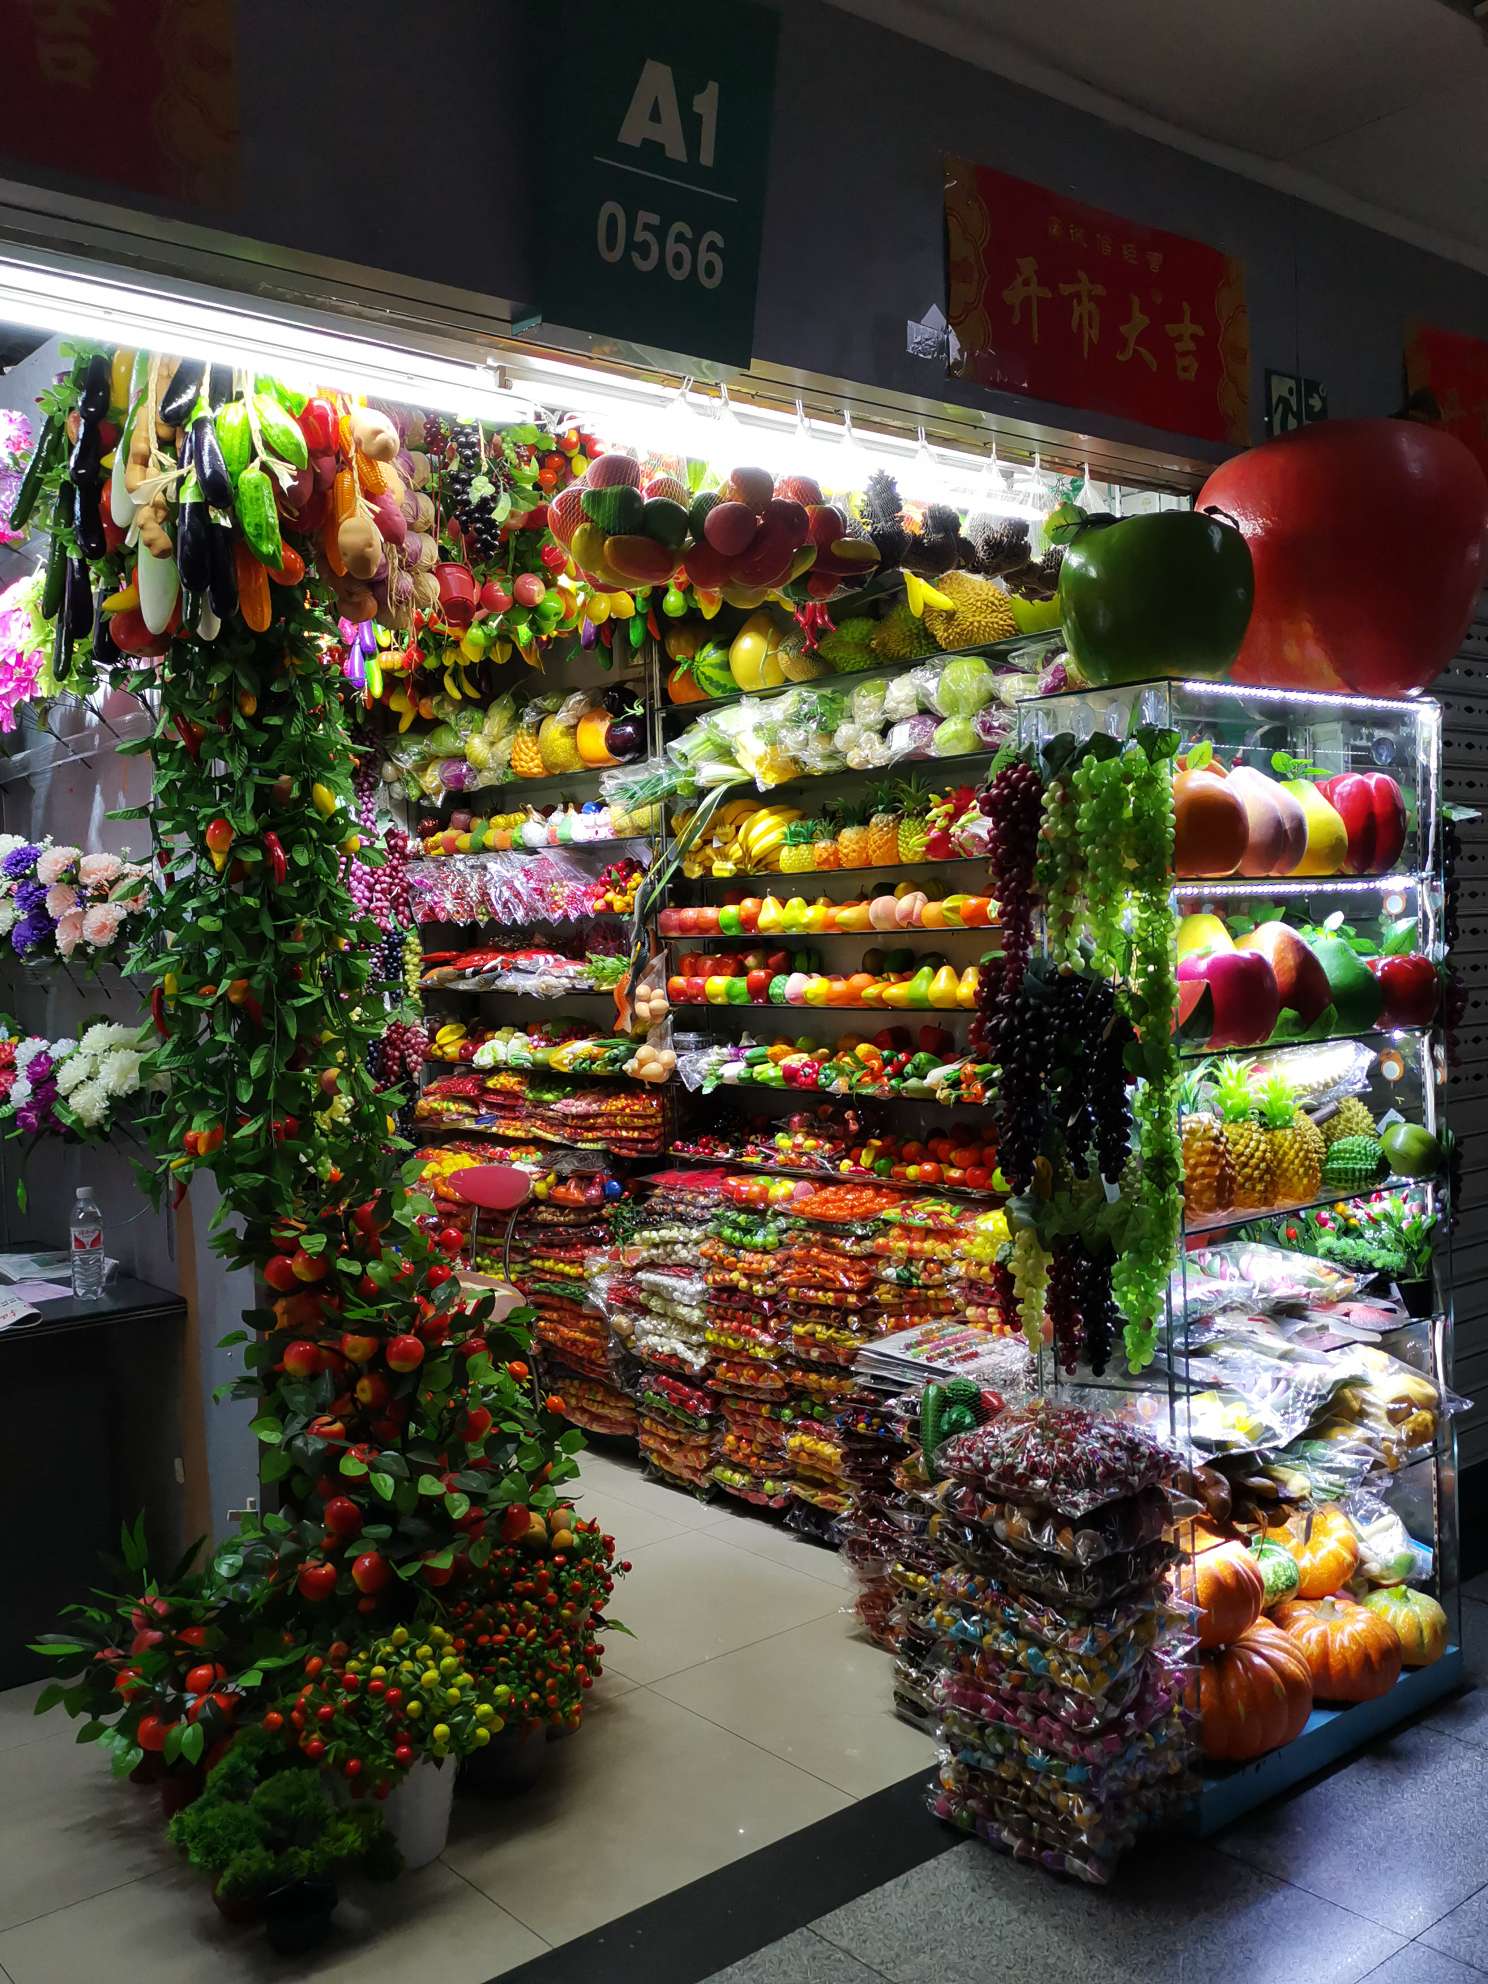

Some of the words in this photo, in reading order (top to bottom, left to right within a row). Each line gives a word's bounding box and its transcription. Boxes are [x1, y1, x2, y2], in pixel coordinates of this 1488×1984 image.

[616, 57, 719, 168] A1
[596, 199, 725, 289] 0566
[1002, 255, 1206, 382] 开市大吉
